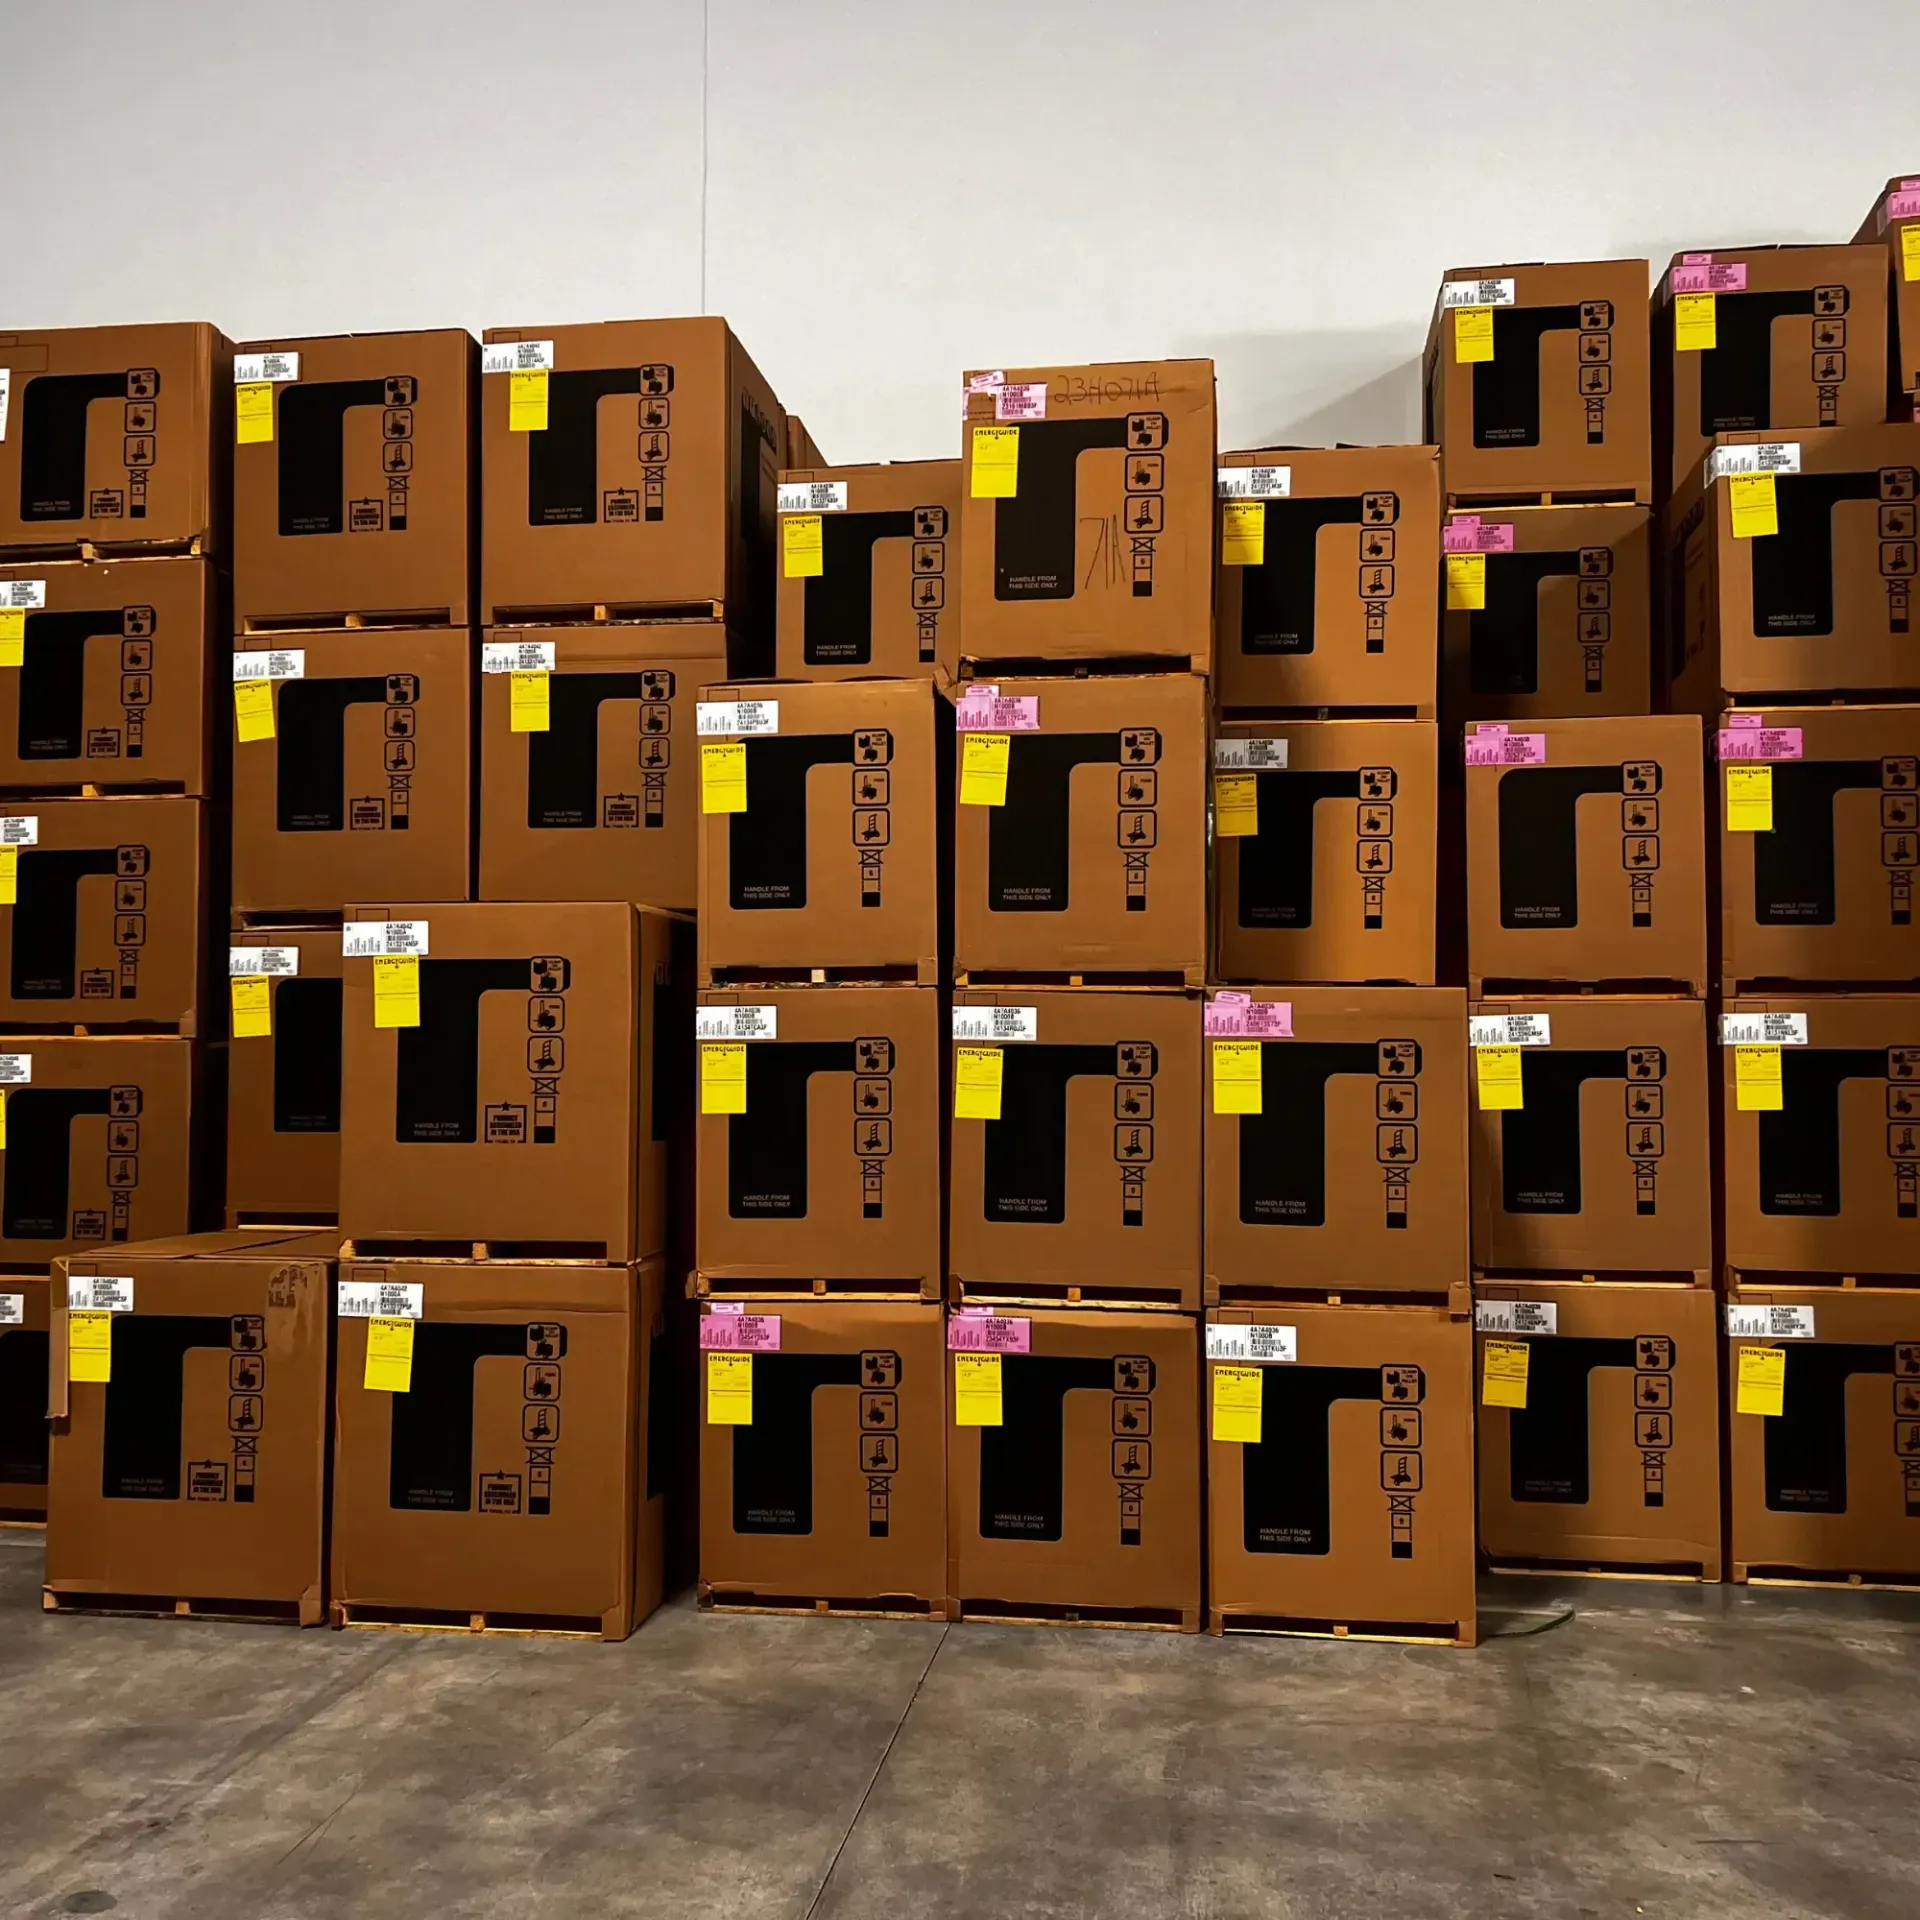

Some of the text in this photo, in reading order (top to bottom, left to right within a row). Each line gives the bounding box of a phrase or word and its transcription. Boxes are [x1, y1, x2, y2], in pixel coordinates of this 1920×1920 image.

[995, 1521, 1044, 1529] THIS SIDE ONLY
[1260, 1528, 1310, 1536] HANDLE FROM
[1259, 1535, 1311, 1543] THIS SIDE ONLY
